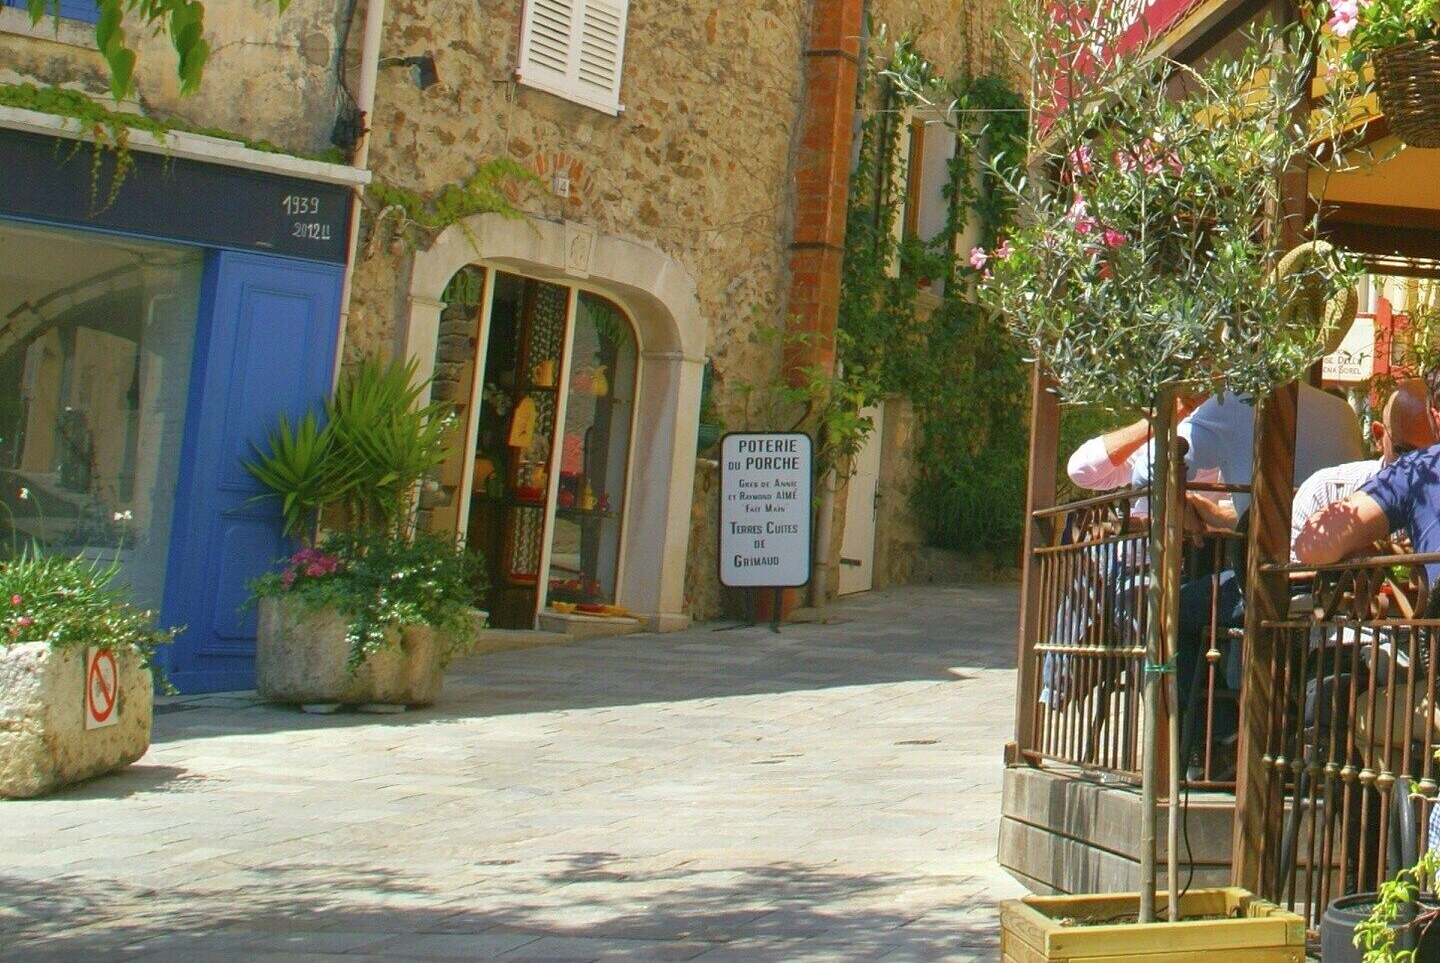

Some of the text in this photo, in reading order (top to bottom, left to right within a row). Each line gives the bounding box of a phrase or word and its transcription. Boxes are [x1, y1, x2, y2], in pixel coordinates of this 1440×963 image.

[282, 195, 319, 215] 1939
[292, 222, 321, 240] 2012
[738, 439, 798, 453] POTERIE
[728, 456, 800, 471] DU PORCHE
[730, 521, 798, 535] TERRES CUITES
[754, 539, 765, 549] DE
[734, 554, 779, 568] GRIMAUD
